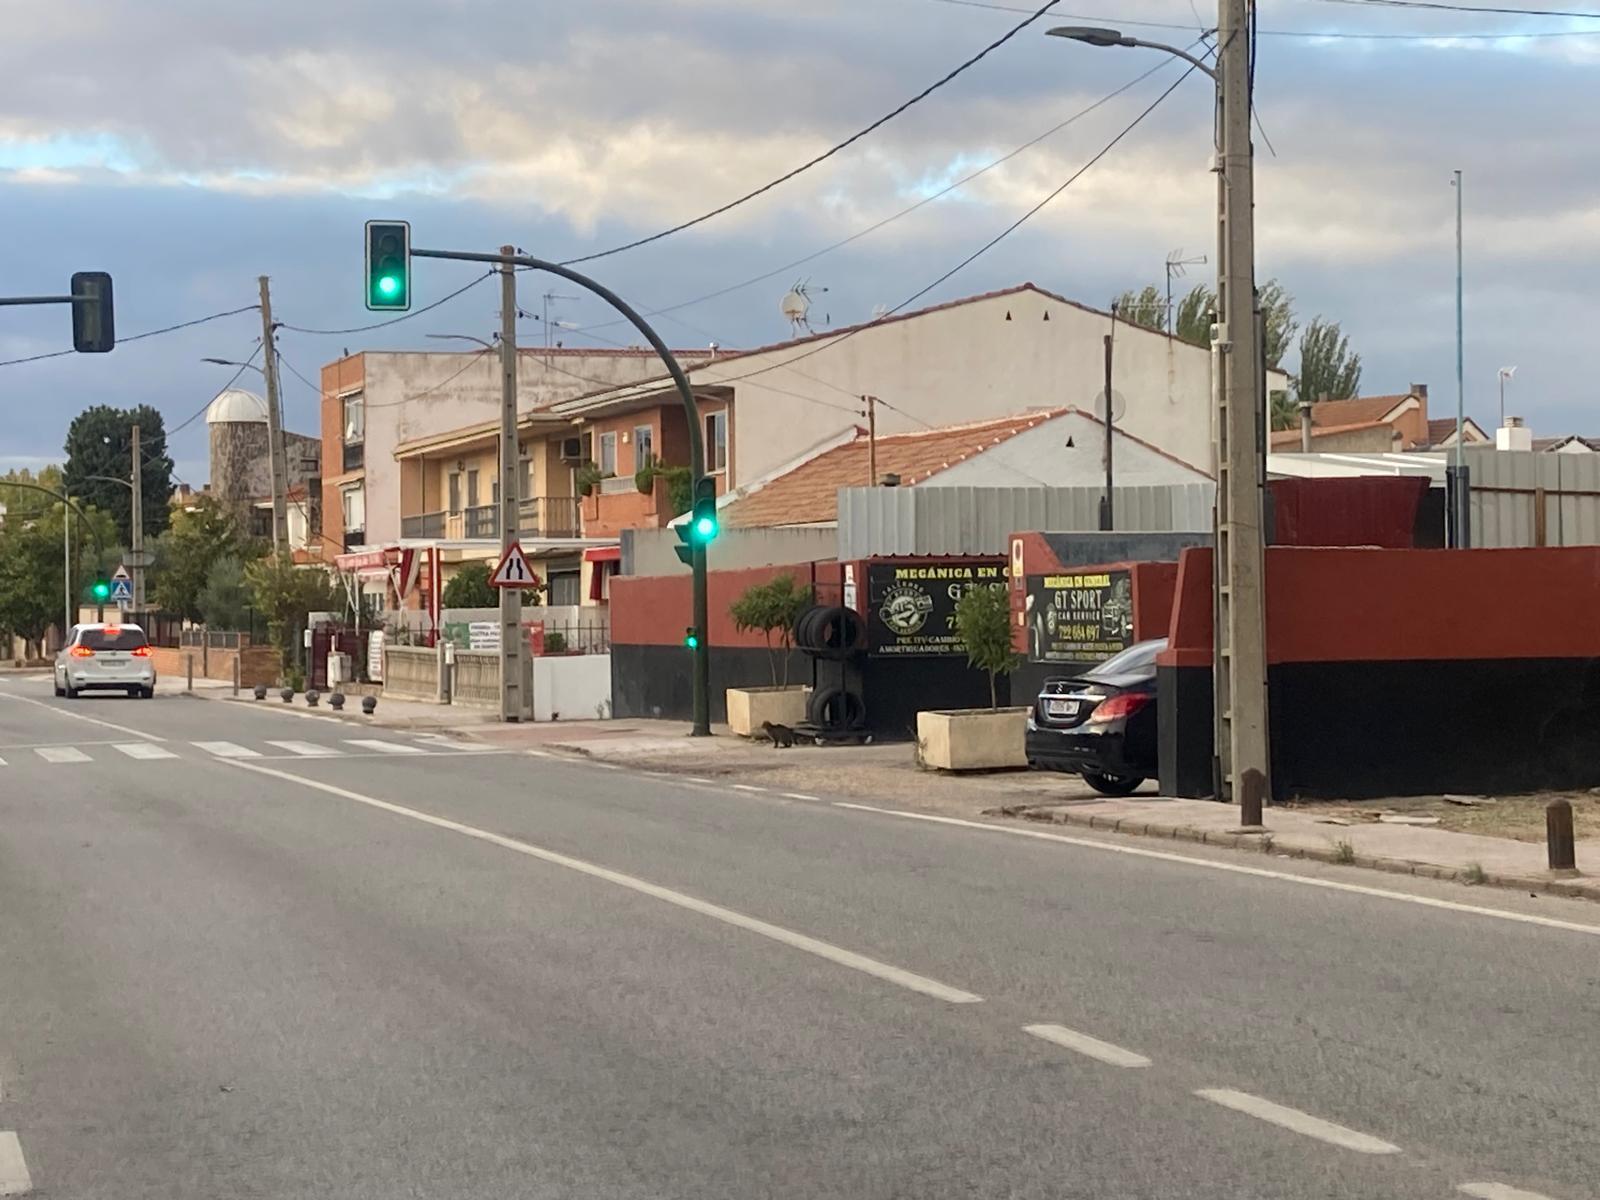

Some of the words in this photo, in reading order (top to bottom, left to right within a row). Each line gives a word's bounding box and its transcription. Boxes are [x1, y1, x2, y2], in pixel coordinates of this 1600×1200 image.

[895, 566, 972, 579] MECÁNICA
[977, 567, 998, 577] EN
[1055, 590, 1068, 609] GT
[1071, 589, 1102, 609] SPORT
